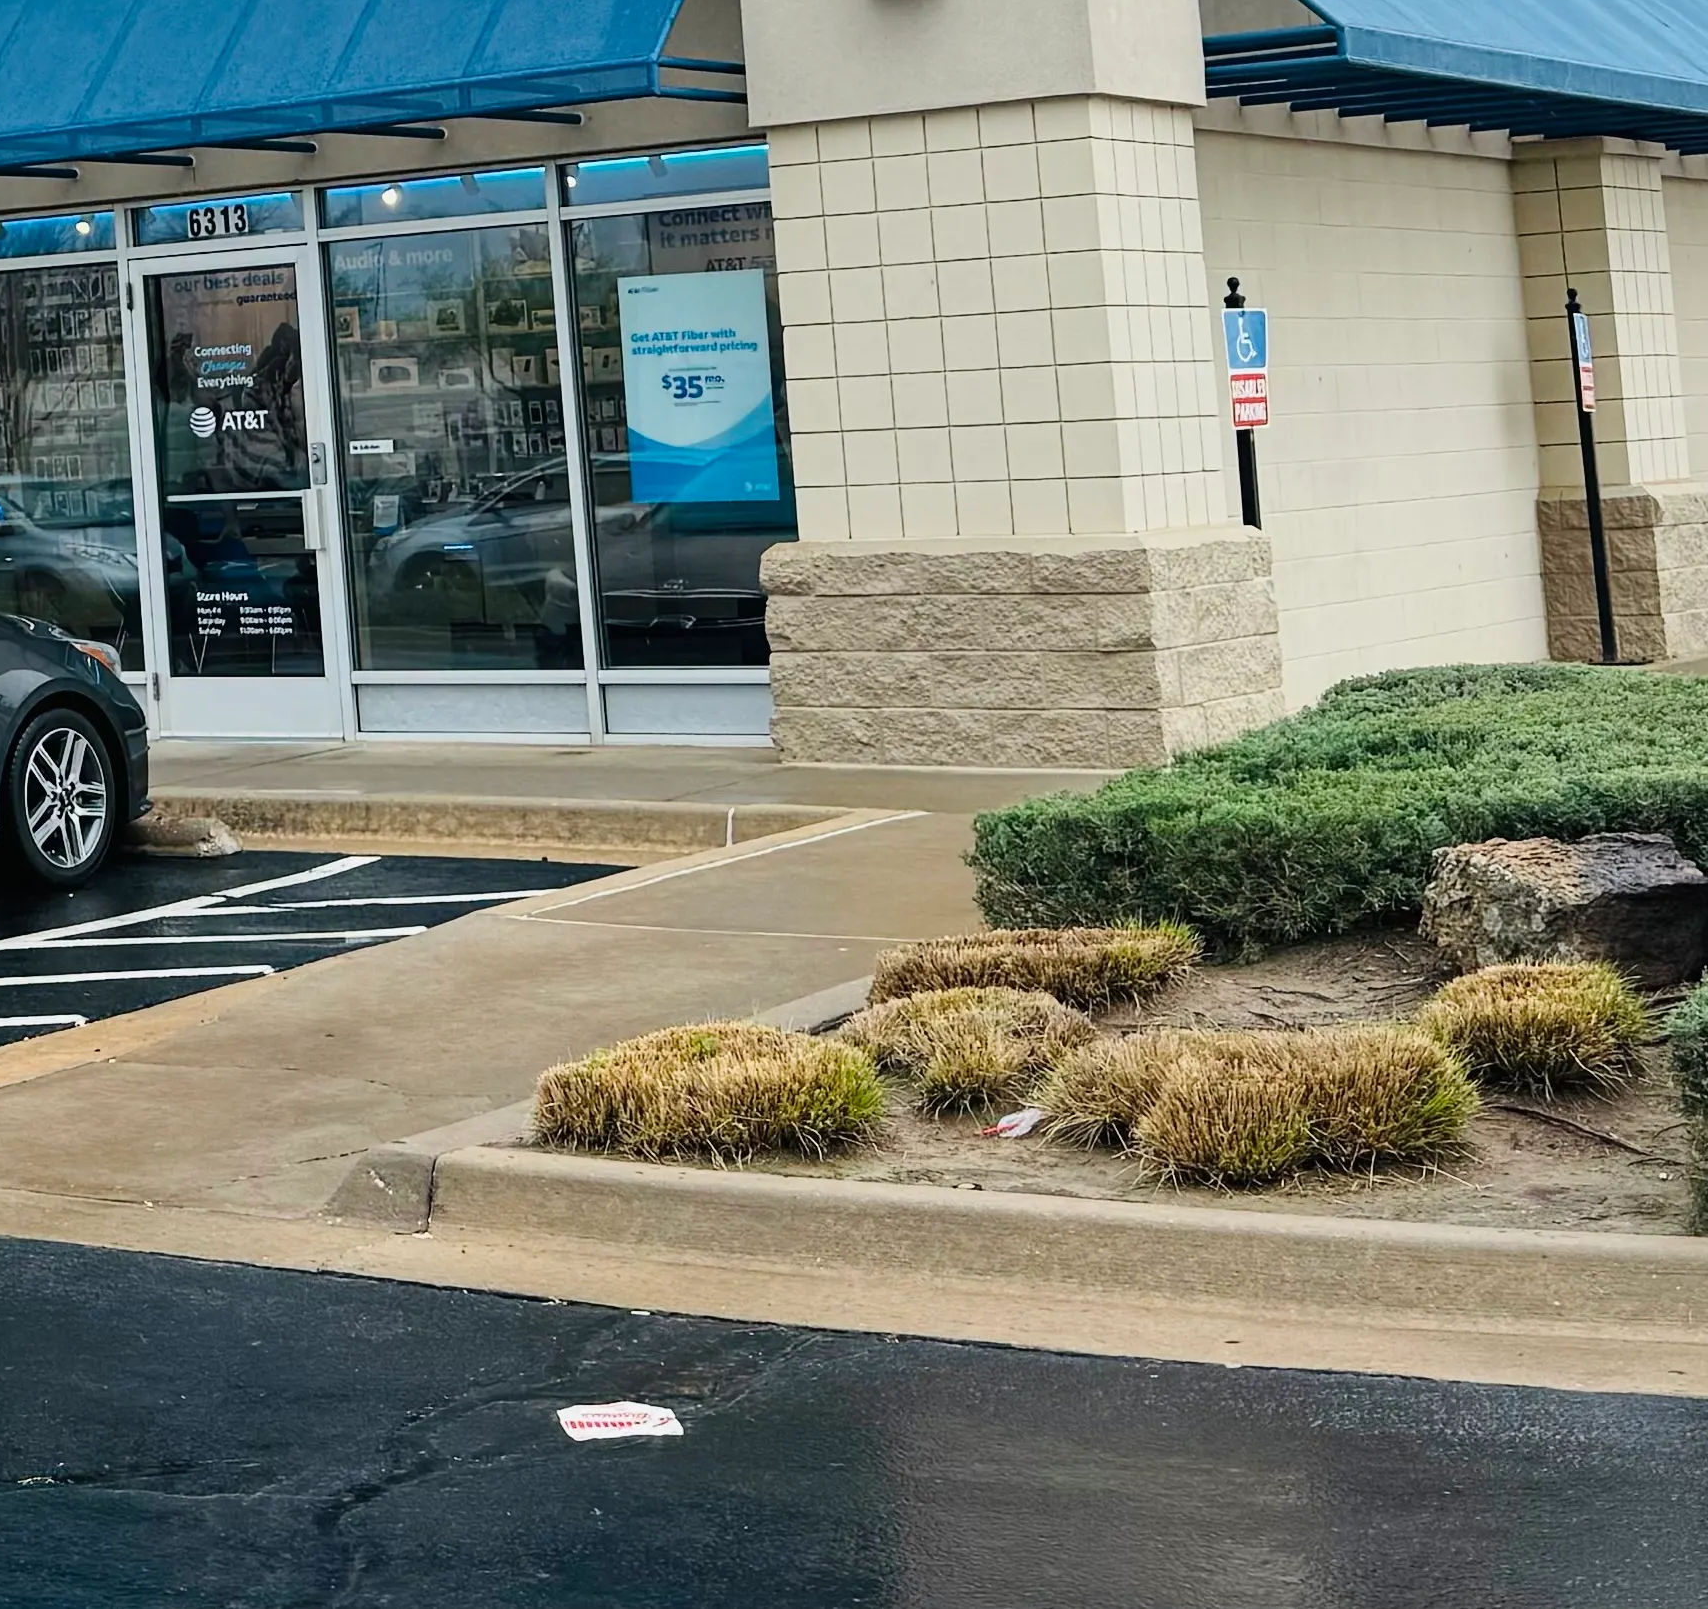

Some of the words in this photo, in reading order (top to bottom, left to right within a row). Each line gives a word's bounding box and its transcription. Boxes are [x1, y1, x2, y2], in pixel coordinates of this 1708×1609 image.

[188, 204, 247, 238] 6313
[659, 206, 740, 227] Connect
[680, 227, 759, 247] matters
[388, 250, 403, 267] &
[406, 248, 453, 265] more
[174, 278, 200, 293] our
[203, 272, 238, 290] best
[242, 271, 285, 288] deals
[682, 330, 708, 340] Fiber
[710, 328, 736, 339] with
[194, 343, 252, 357] Connecting
[632, 341, 717, 356] straightforward
[719, 340, 758, 354] pricing
[661, 373, 704, 399] $35
[221, 410, 269, 431] AT&T
